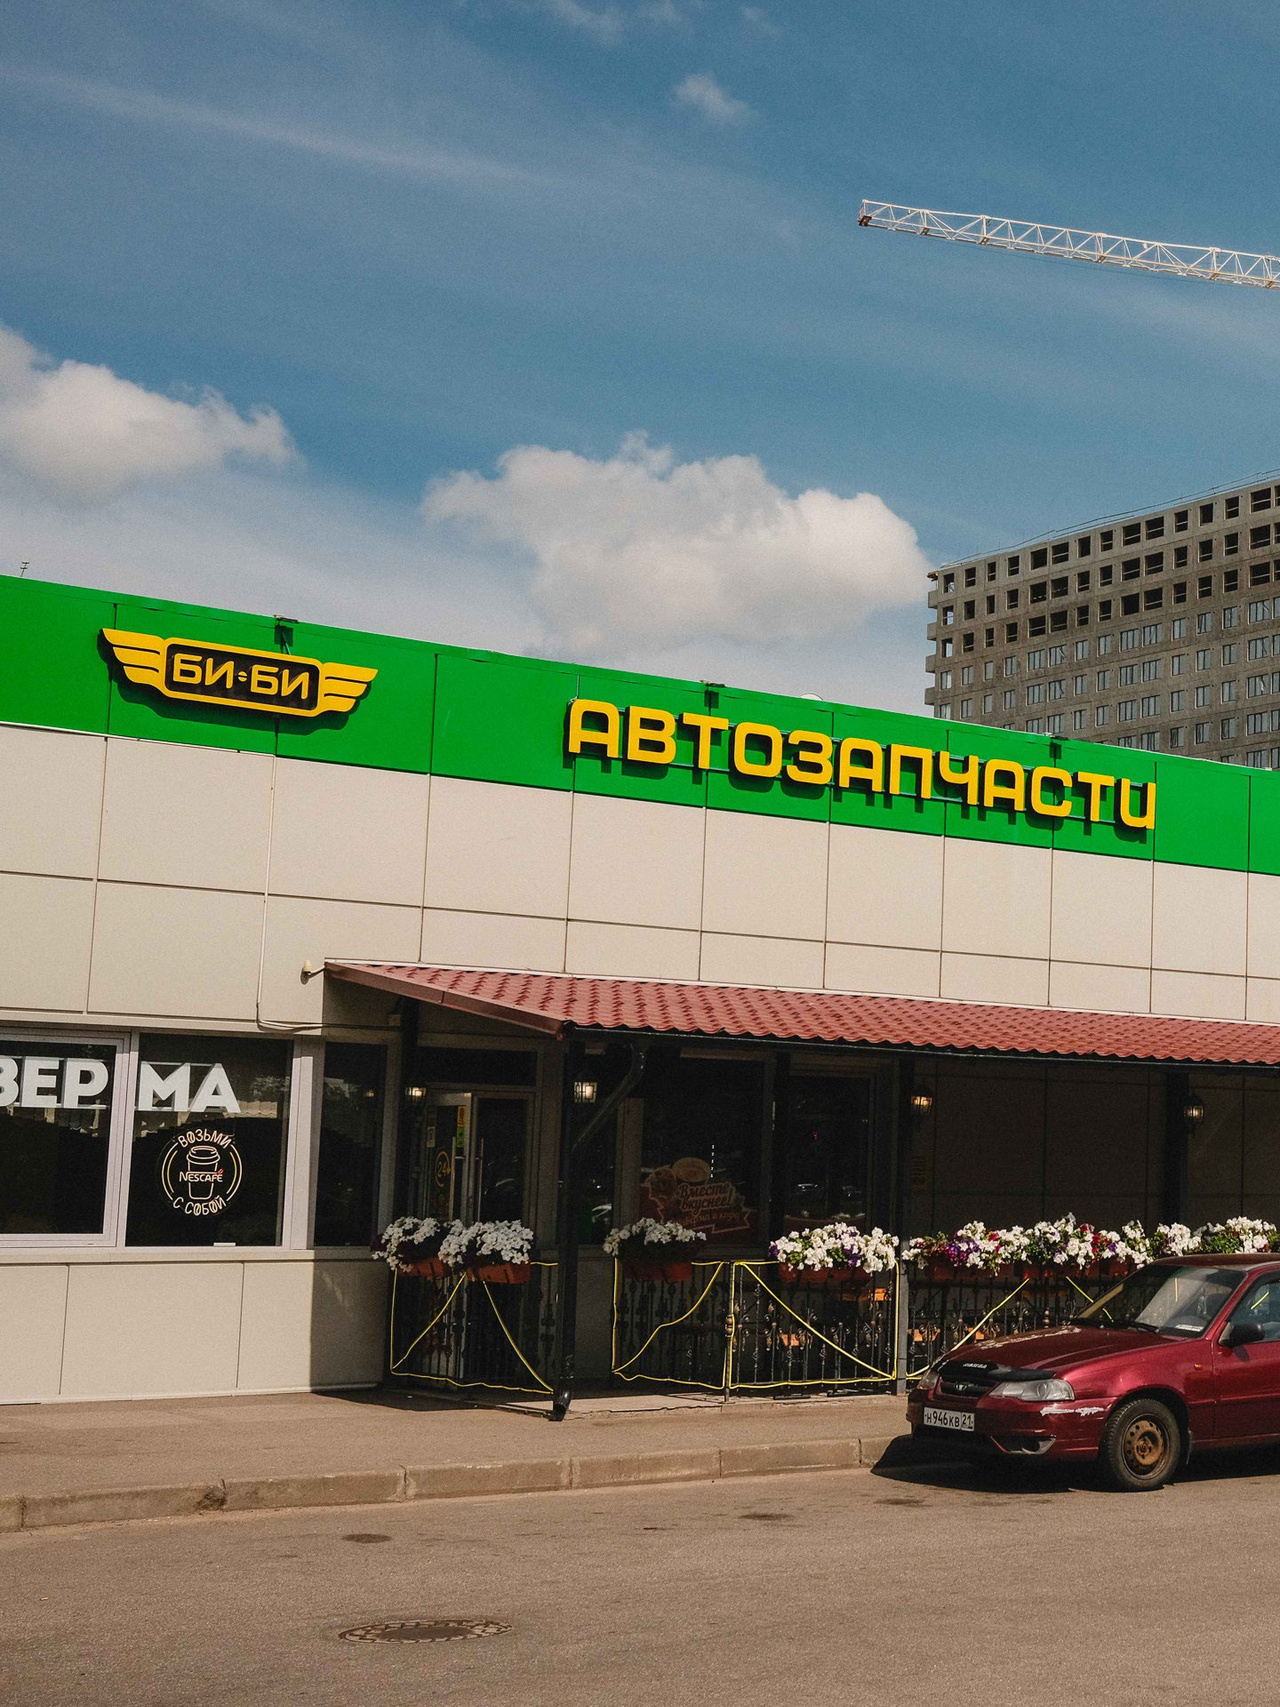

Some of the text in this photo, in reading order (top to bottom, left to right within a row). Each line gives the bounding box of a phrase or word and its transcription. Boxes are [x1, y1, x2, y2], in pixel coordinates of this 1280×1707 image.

[568, 698, 1157, 830] АВТОЗАПЧАСТИ
[178, 1128, 232, 1149] ВОЗЬМИ
[185, 1195, 227, 1216] СОБОЙ
[926, 1411, 972, 1427] Н946КВ 21
